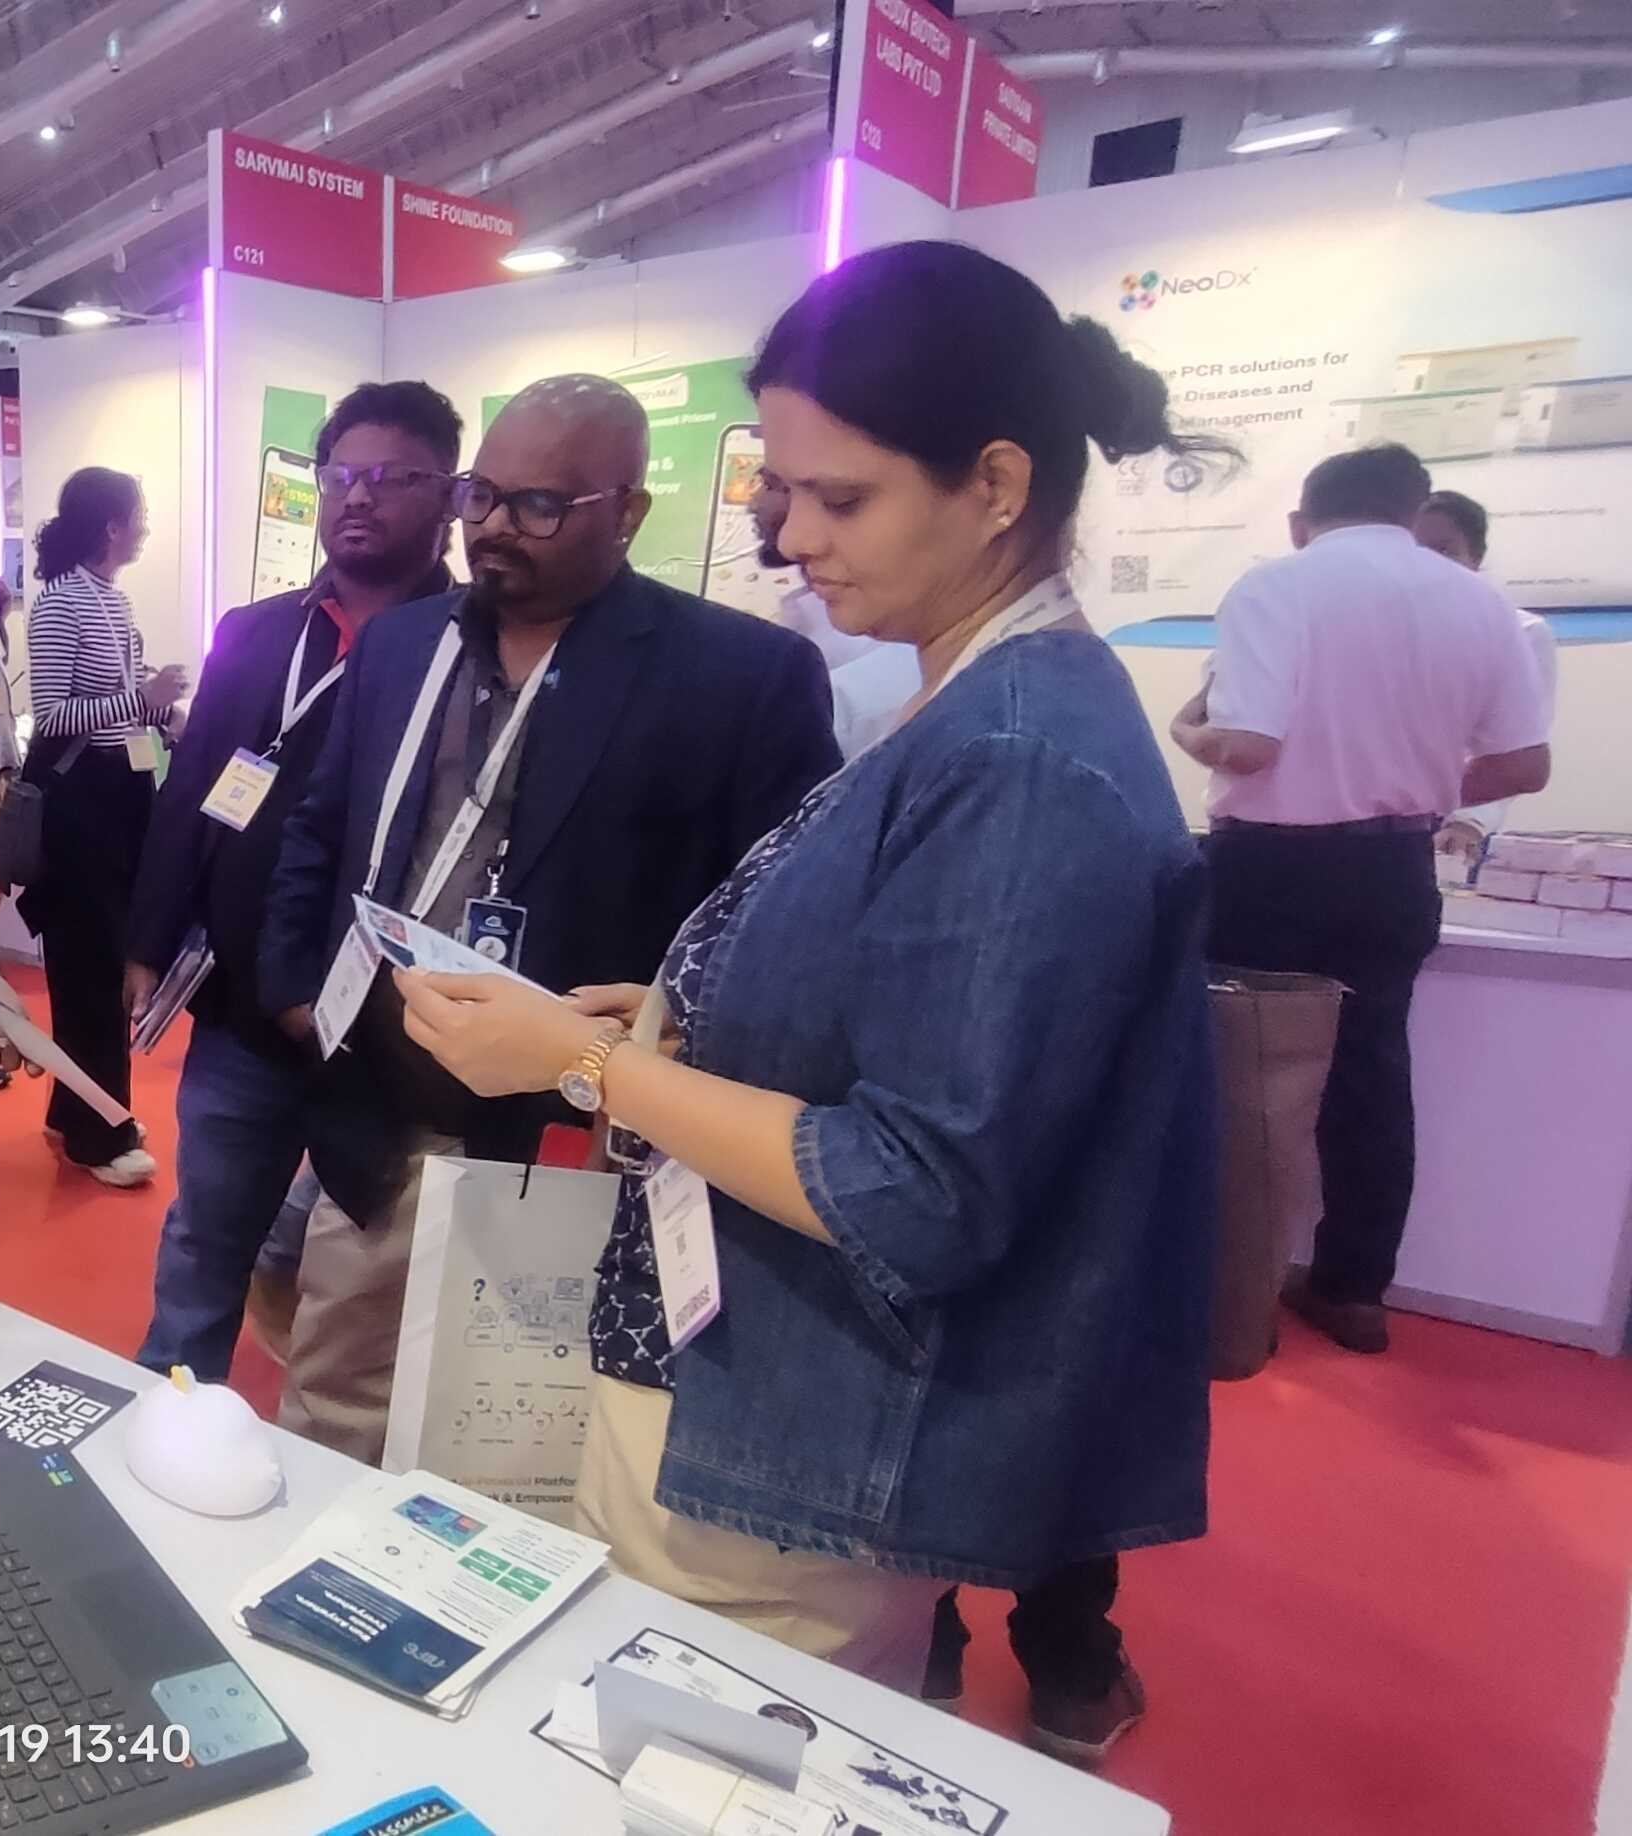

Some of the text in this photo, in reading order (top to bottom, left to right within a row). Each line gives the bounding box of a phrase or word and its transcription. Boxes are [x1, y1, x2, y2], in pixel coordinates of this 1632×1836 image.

[903, 52, 923, 85] PVT
[923, 65, 942, 97] LTD
[234, 147, 364, 200] SARVMAI SYSTEM
[401, 193, 514, 237] SHINE FOUNDATION
[233, 245, 265, 266] C121
[1160, 269, 1253, 297] NeoDx
[1181, 364, 1224, 379] PCR
[1229, 356, 1317, 376] solutions
[1323, 351, 1350, 366] for
[1185, 385, 1273, 402] Diseases
[1277, 380, 1314, 394] and
[1179, 407, 1304, 429] Management
[534, 1475, 577, 1488] Platfor
[368, 1802, 448, 1836] lassmate
